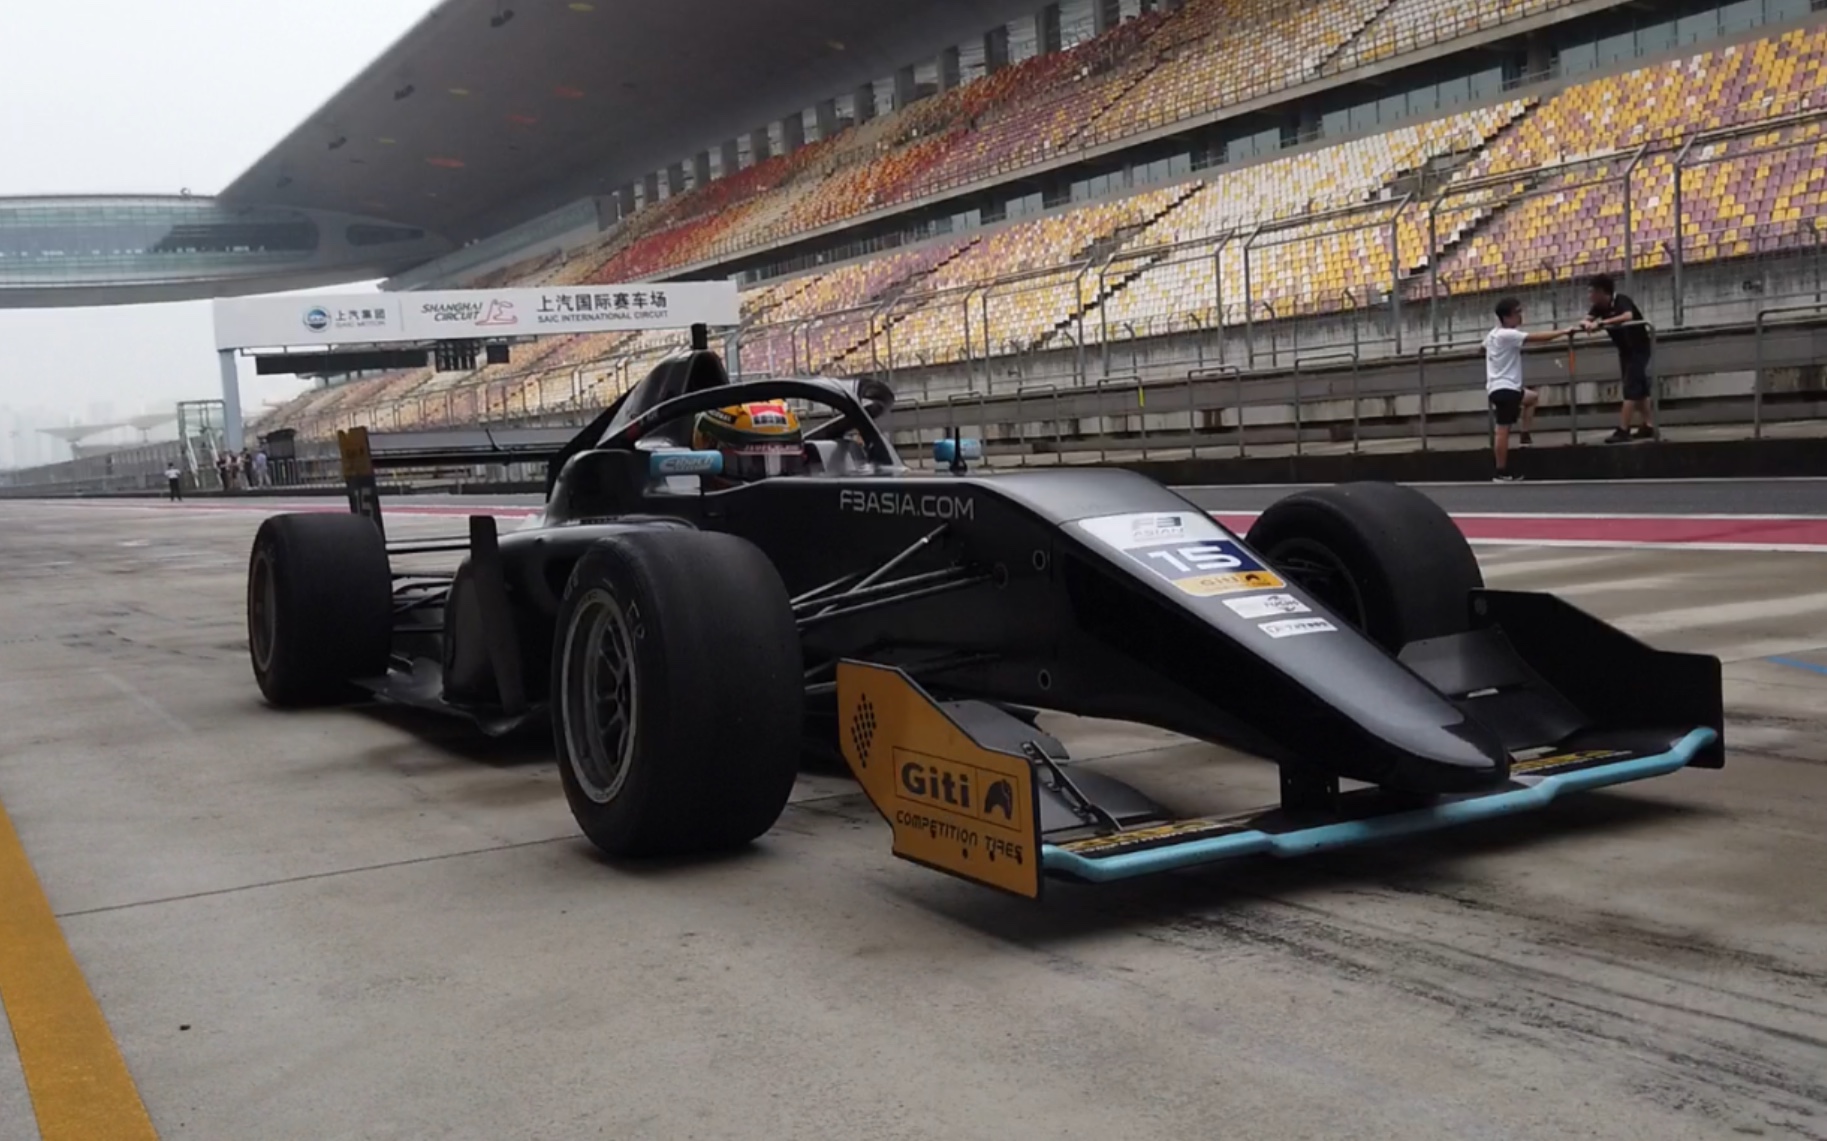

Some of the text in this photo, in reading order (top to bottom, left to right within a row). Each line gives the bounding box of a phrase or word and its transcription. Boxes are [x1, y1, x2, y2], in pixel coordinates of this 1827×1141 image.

[421, 302, 483, 313] SHANGHAI
[537, 291, 667, 313] 上汽国际赛车场
[434, 311, 481, 322] CIRCUIT
[538, 310, 668, 323] SAIC INTERNATIONAL CIRCUIT
[839, 489, 975, 521] F3ASIA.COM
[1148, 546, 1242, 572] 15
[902, 762, 971, 808] Giti
[896, 810, 978, 847] COMPETITION
[985, 835, 1023, 860] TIRES
